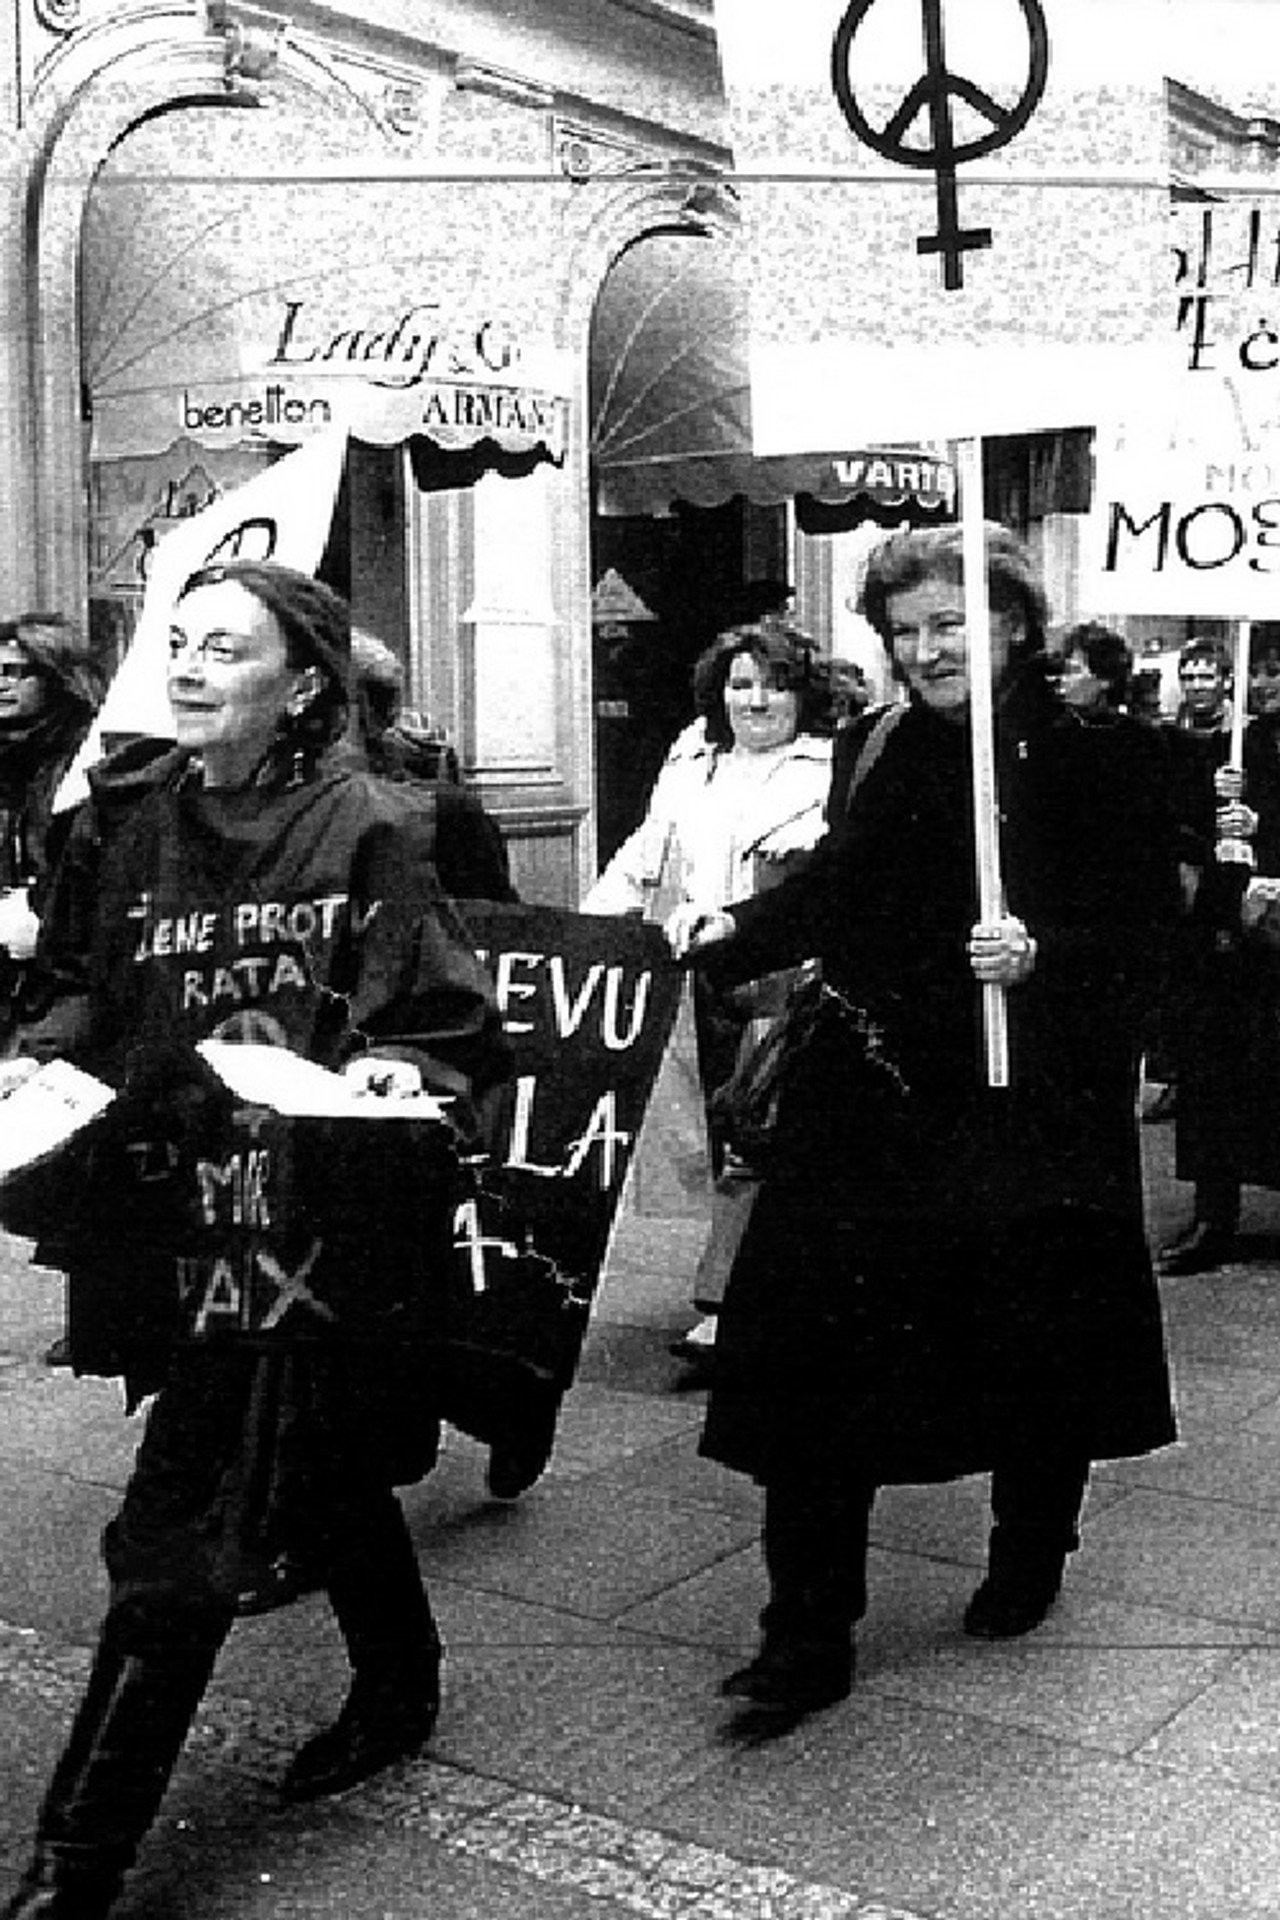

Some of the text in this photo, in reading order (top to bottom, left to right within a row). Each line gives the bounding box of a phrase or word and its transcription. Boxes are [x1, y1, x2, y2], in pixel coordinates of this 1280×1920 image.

[184, 385, 332, 429] benetton
[184, 954, 306, 1009] RATA
[475, 951, 651, 1050] EVU
[458, 1076, 633, 1191] LA
